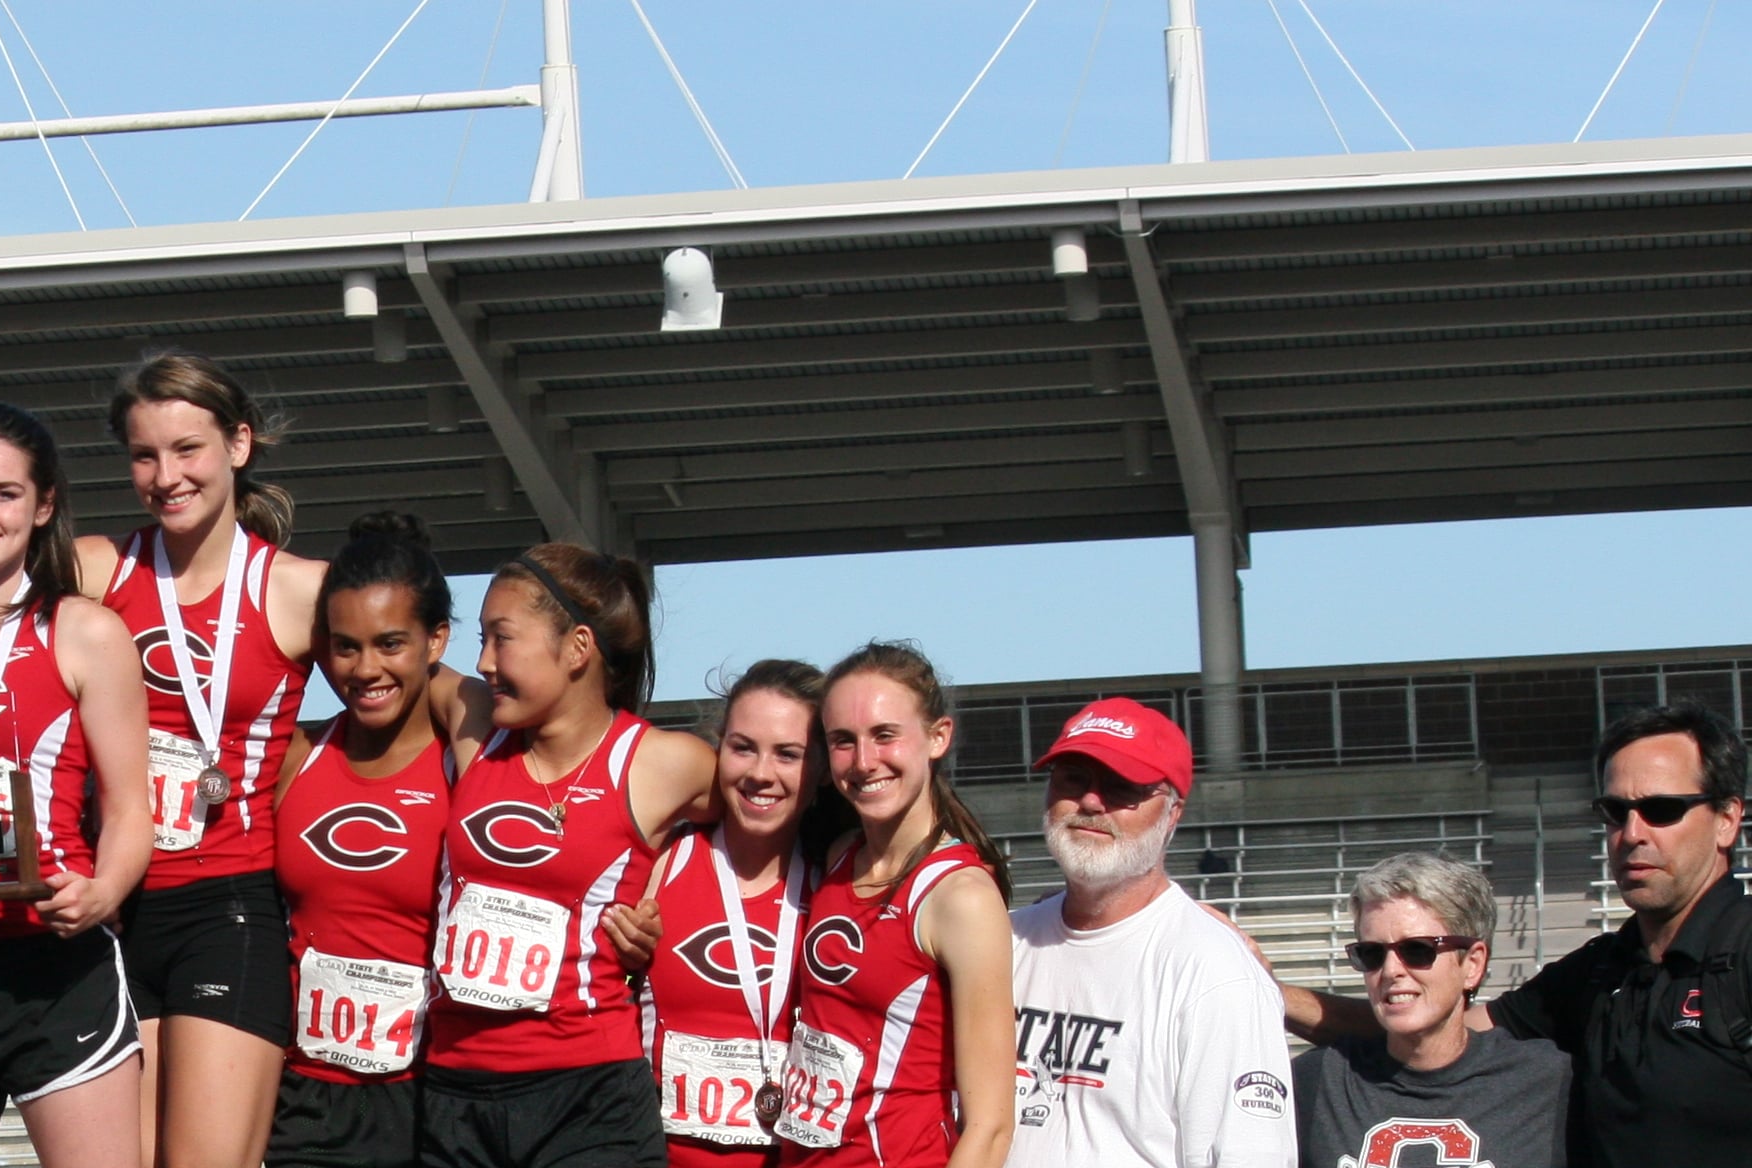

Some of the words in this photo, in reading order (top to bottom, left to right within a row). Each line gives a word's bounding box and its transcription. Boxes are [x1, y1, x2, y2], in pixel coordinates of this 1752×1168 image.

[300, 802, 408, 872] C
[459, 800, 564, 868] C
[438, 923, 552, 993] 1018
[803, 914, 864, 986] C
[306, 987, 418, 1058] 1014
[456, 986, 525, 1009] BROOKS
[329, 1050, 390, 1073] BROOKS
[1015, 1007, 1125, 1074] TATE
